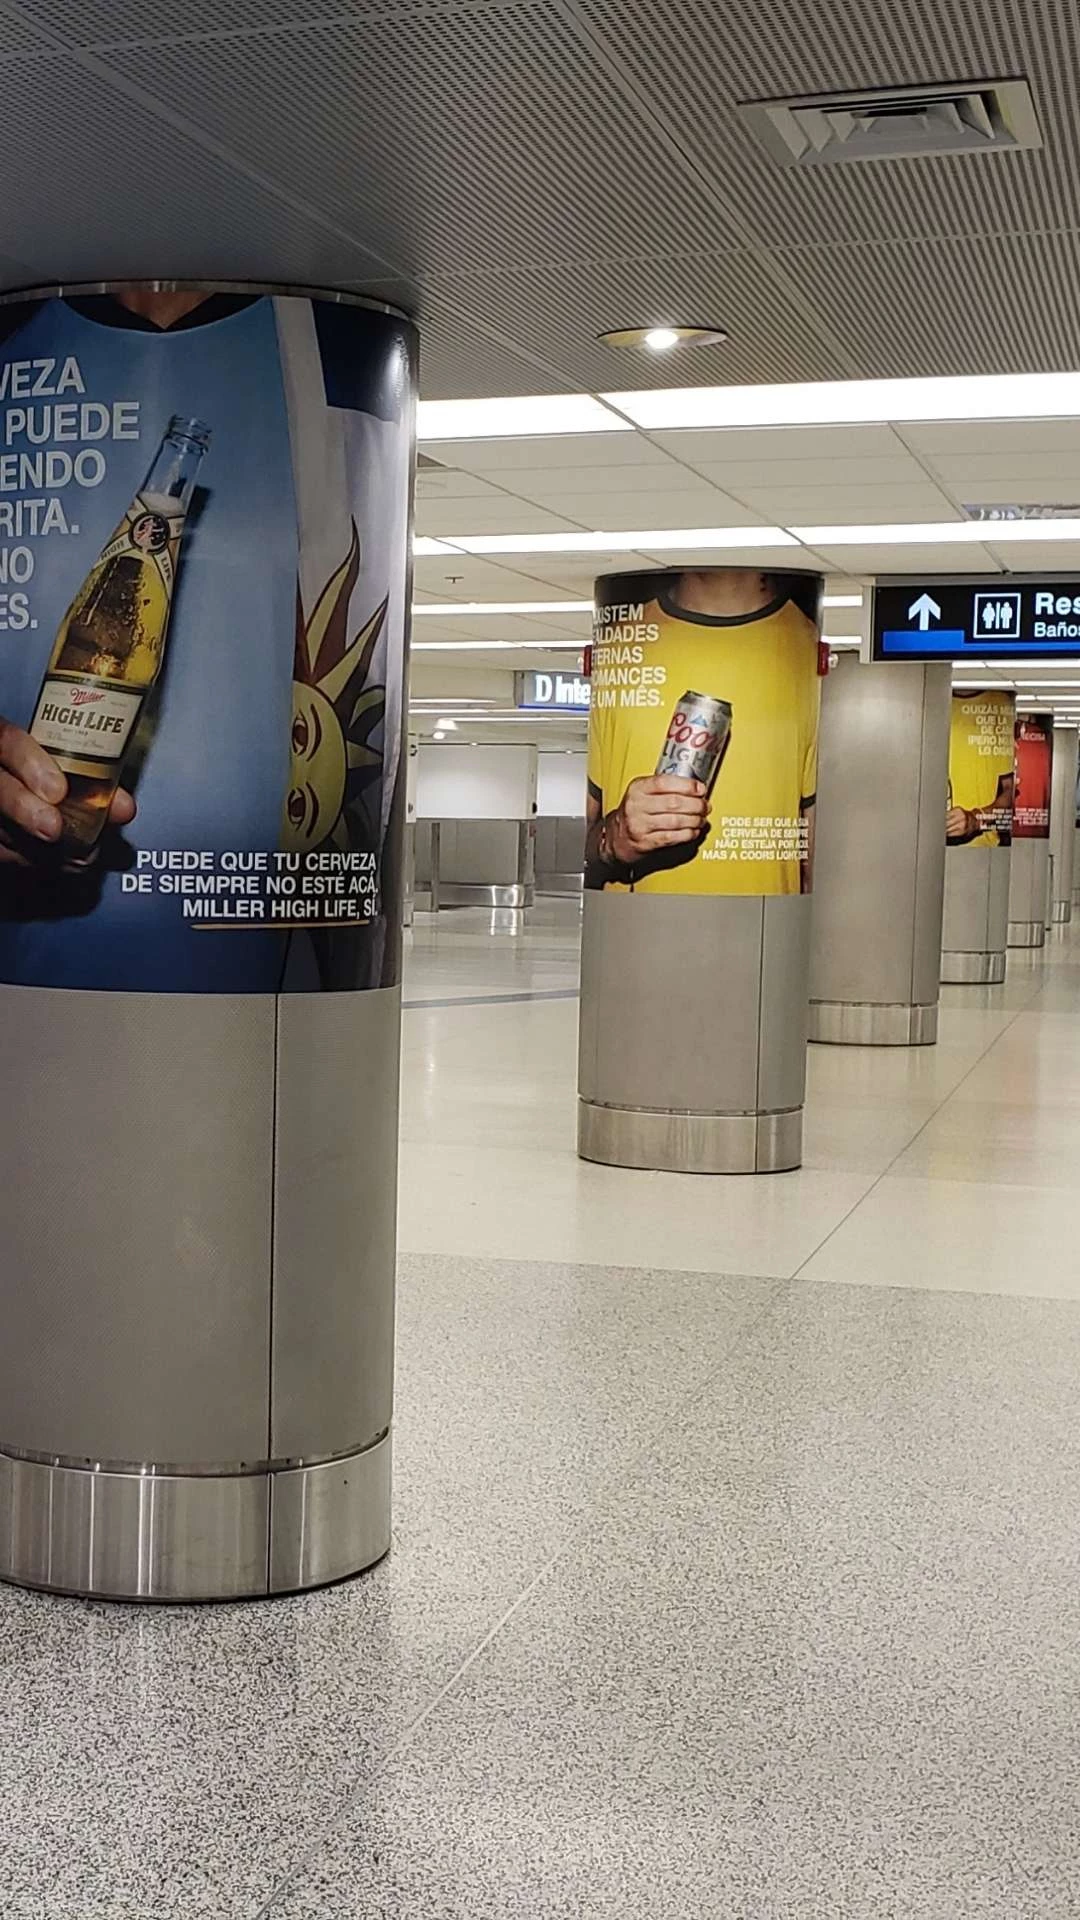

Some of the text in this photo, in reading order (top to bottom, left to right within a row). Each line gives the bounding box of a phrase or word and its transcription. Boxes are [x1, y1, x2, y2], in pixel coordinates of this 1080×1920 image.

[6, 402, 140, 446] PUEDE
[1034, 621, 1080, 638] Baño
[535, 674, 552, 703] D
[597, 690, 617, 708] UM
[620, 684, 665, 707] MÊS.
[40, 703, 84, 728] HIGH
[84, 711, 124, 734] LIFE
[137, 850, 377, 872] PUEDE QUE TU CERVEZA
[702, 849, 727, 860] MAS
[729, 850, 738, 860] A
[122, 871, 379, 895] DE SIEMPRE NO ESTÉ ACÁ.
[183, 893, 379, 920] MILLER HIGH LIFE, SÍ.
